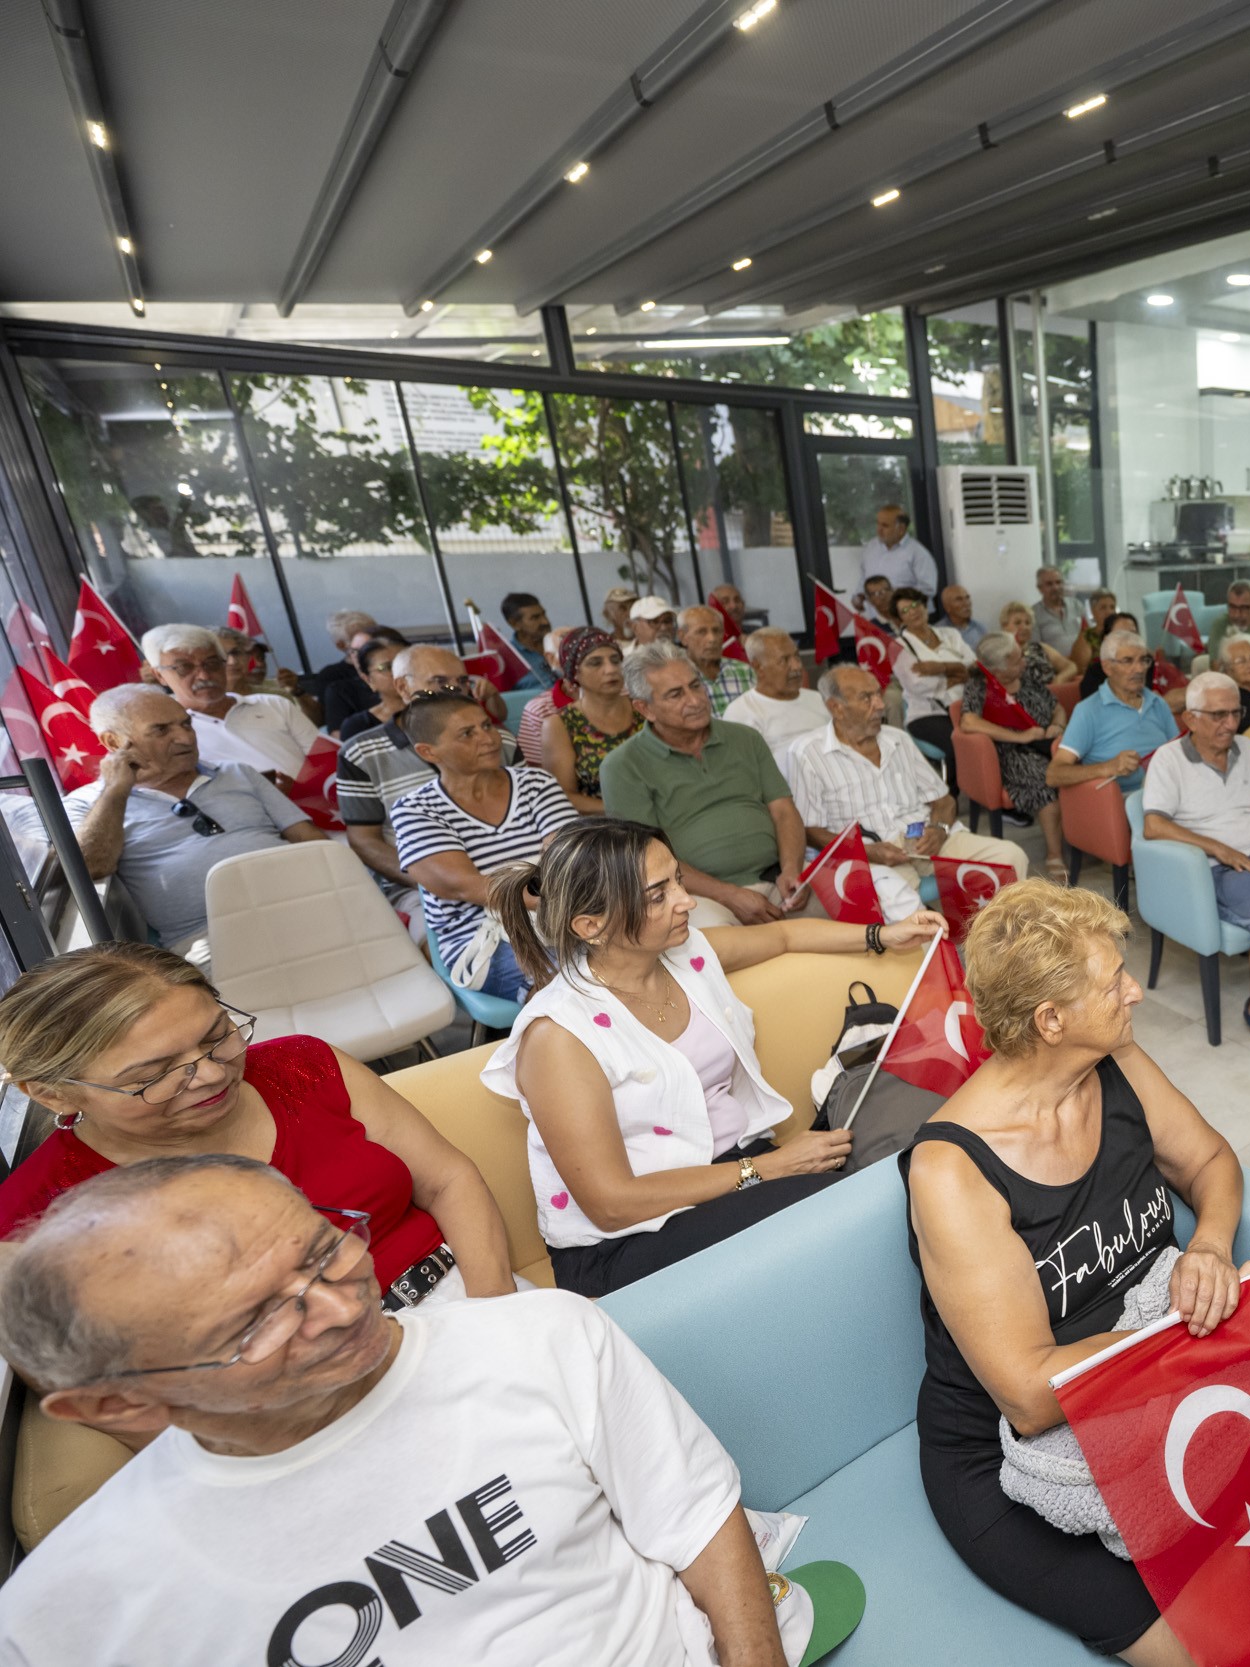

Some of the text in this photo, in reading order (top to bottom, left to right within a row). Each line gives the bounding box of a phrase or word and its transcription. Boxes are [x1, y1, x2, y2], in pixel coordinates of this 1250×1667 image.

[1035, 1186, 1171, 1318] Fabulous
[1145, 1215, 1167, 1238] WOMAN
[267, 1473, 538, 1667] ONE
